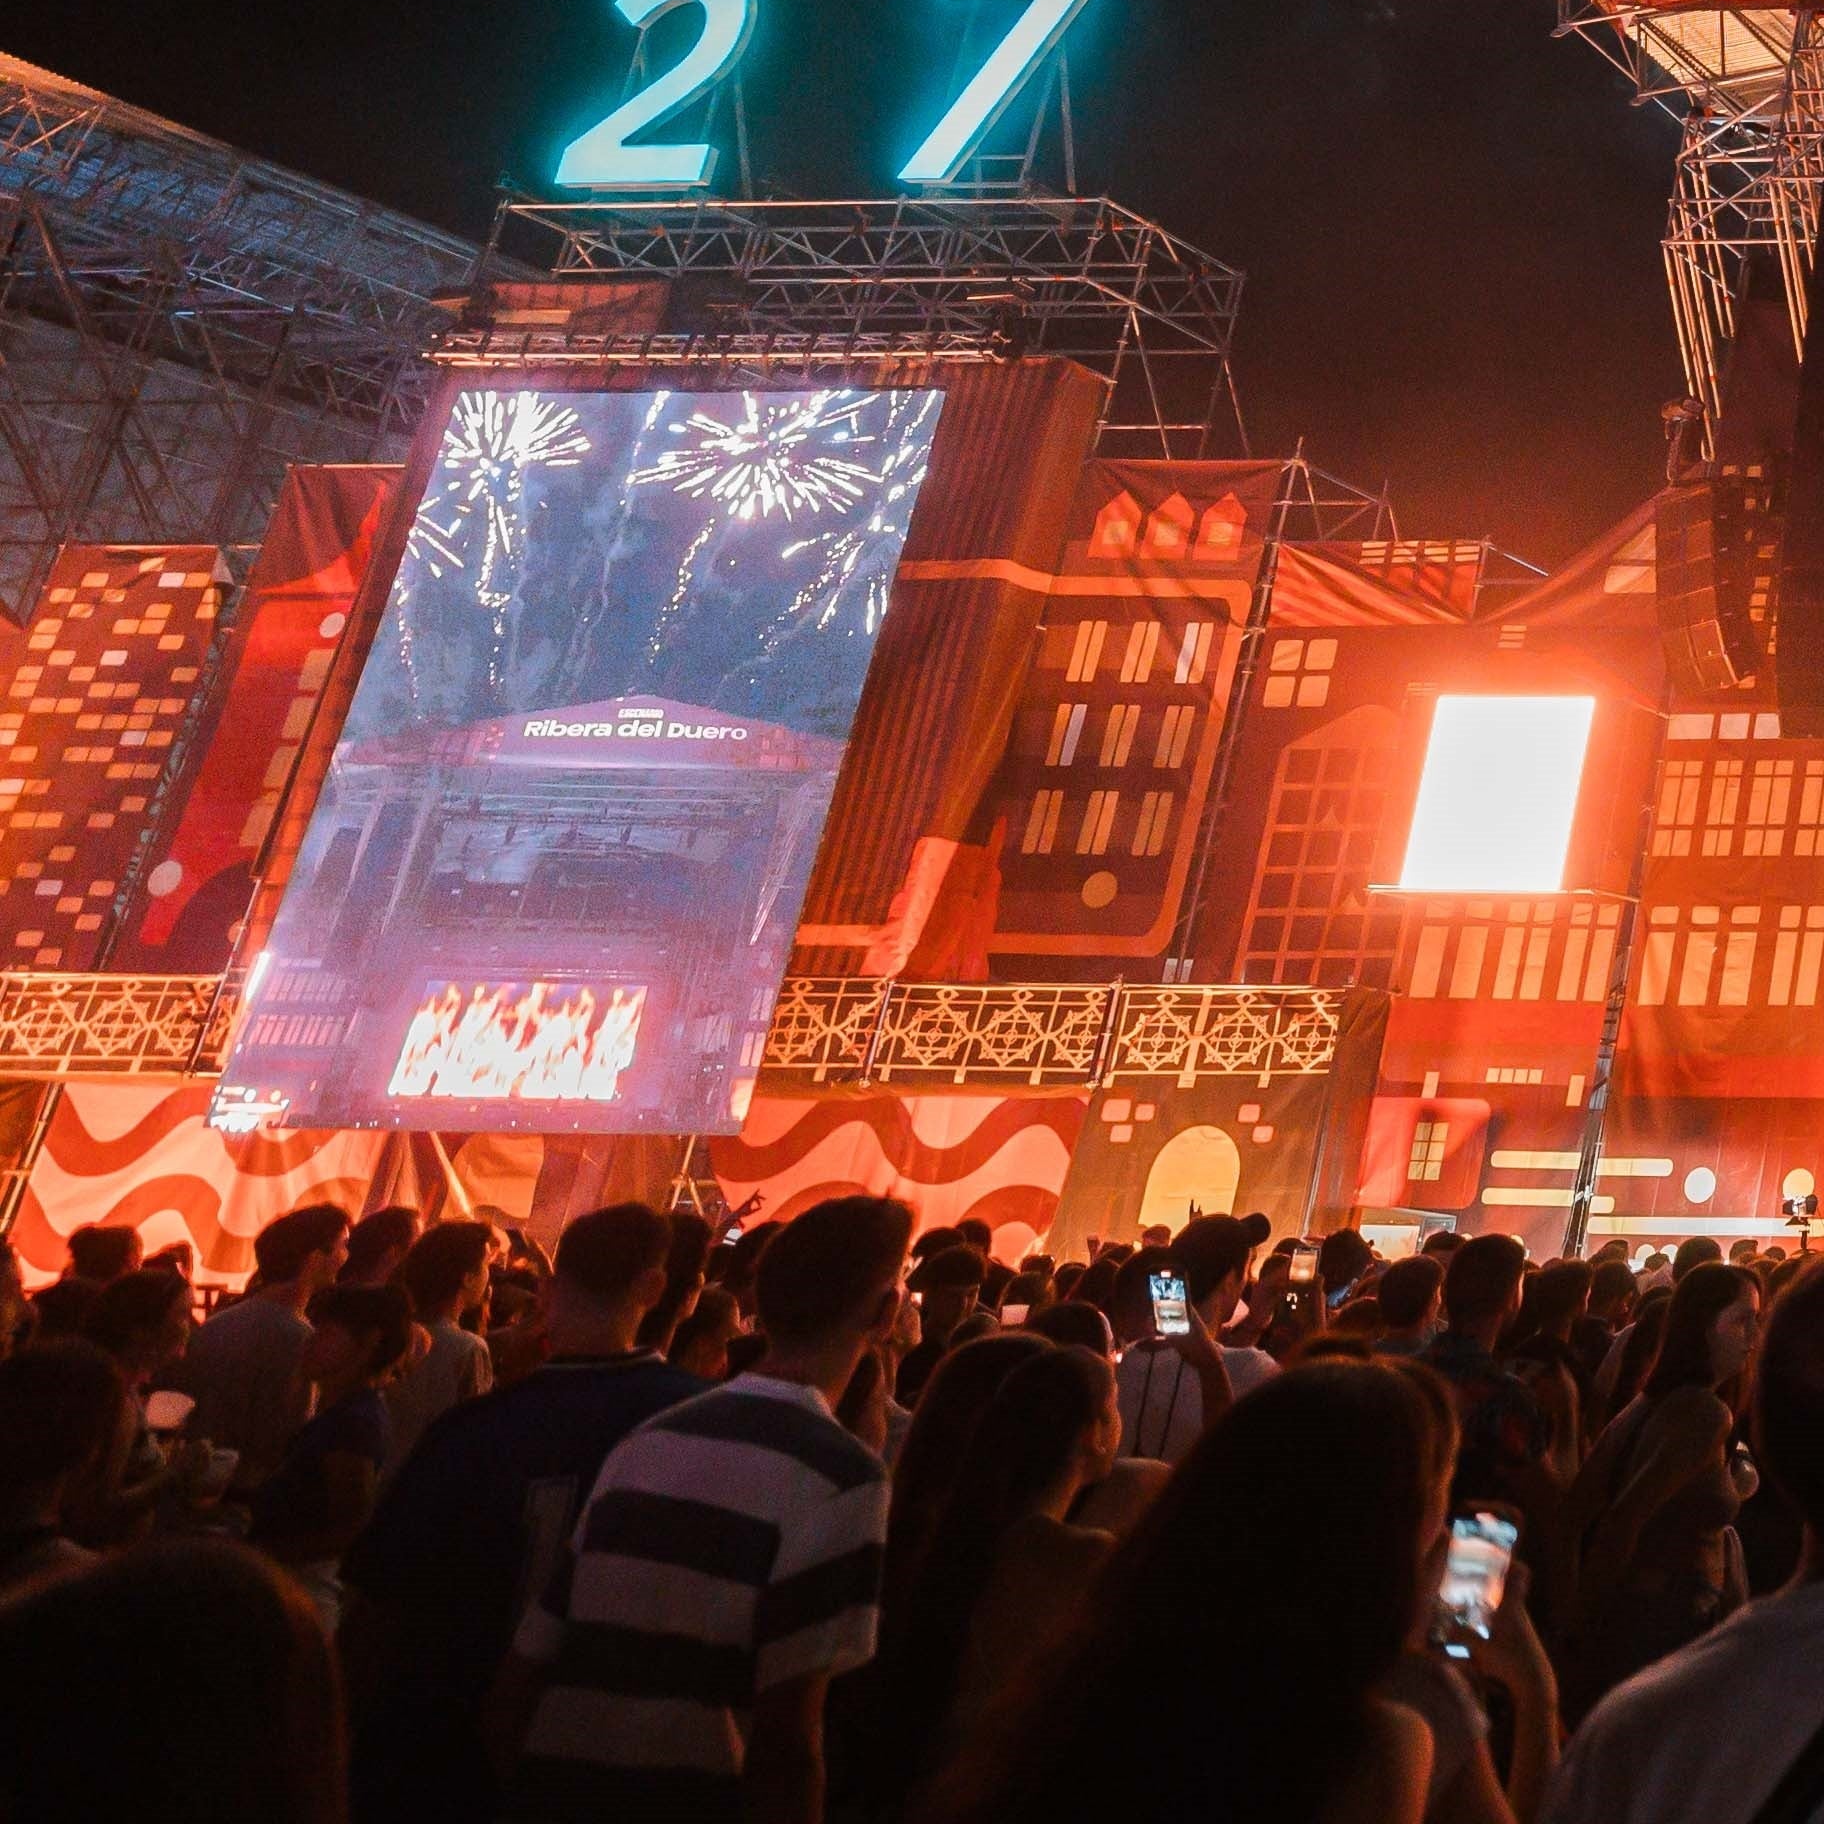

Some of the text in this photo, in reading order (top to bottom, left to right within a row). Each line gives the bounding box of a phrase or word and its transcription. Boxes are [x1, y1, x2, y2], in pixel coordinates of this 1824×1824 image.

[523, 719, 748, 740] Ribera del Duero
